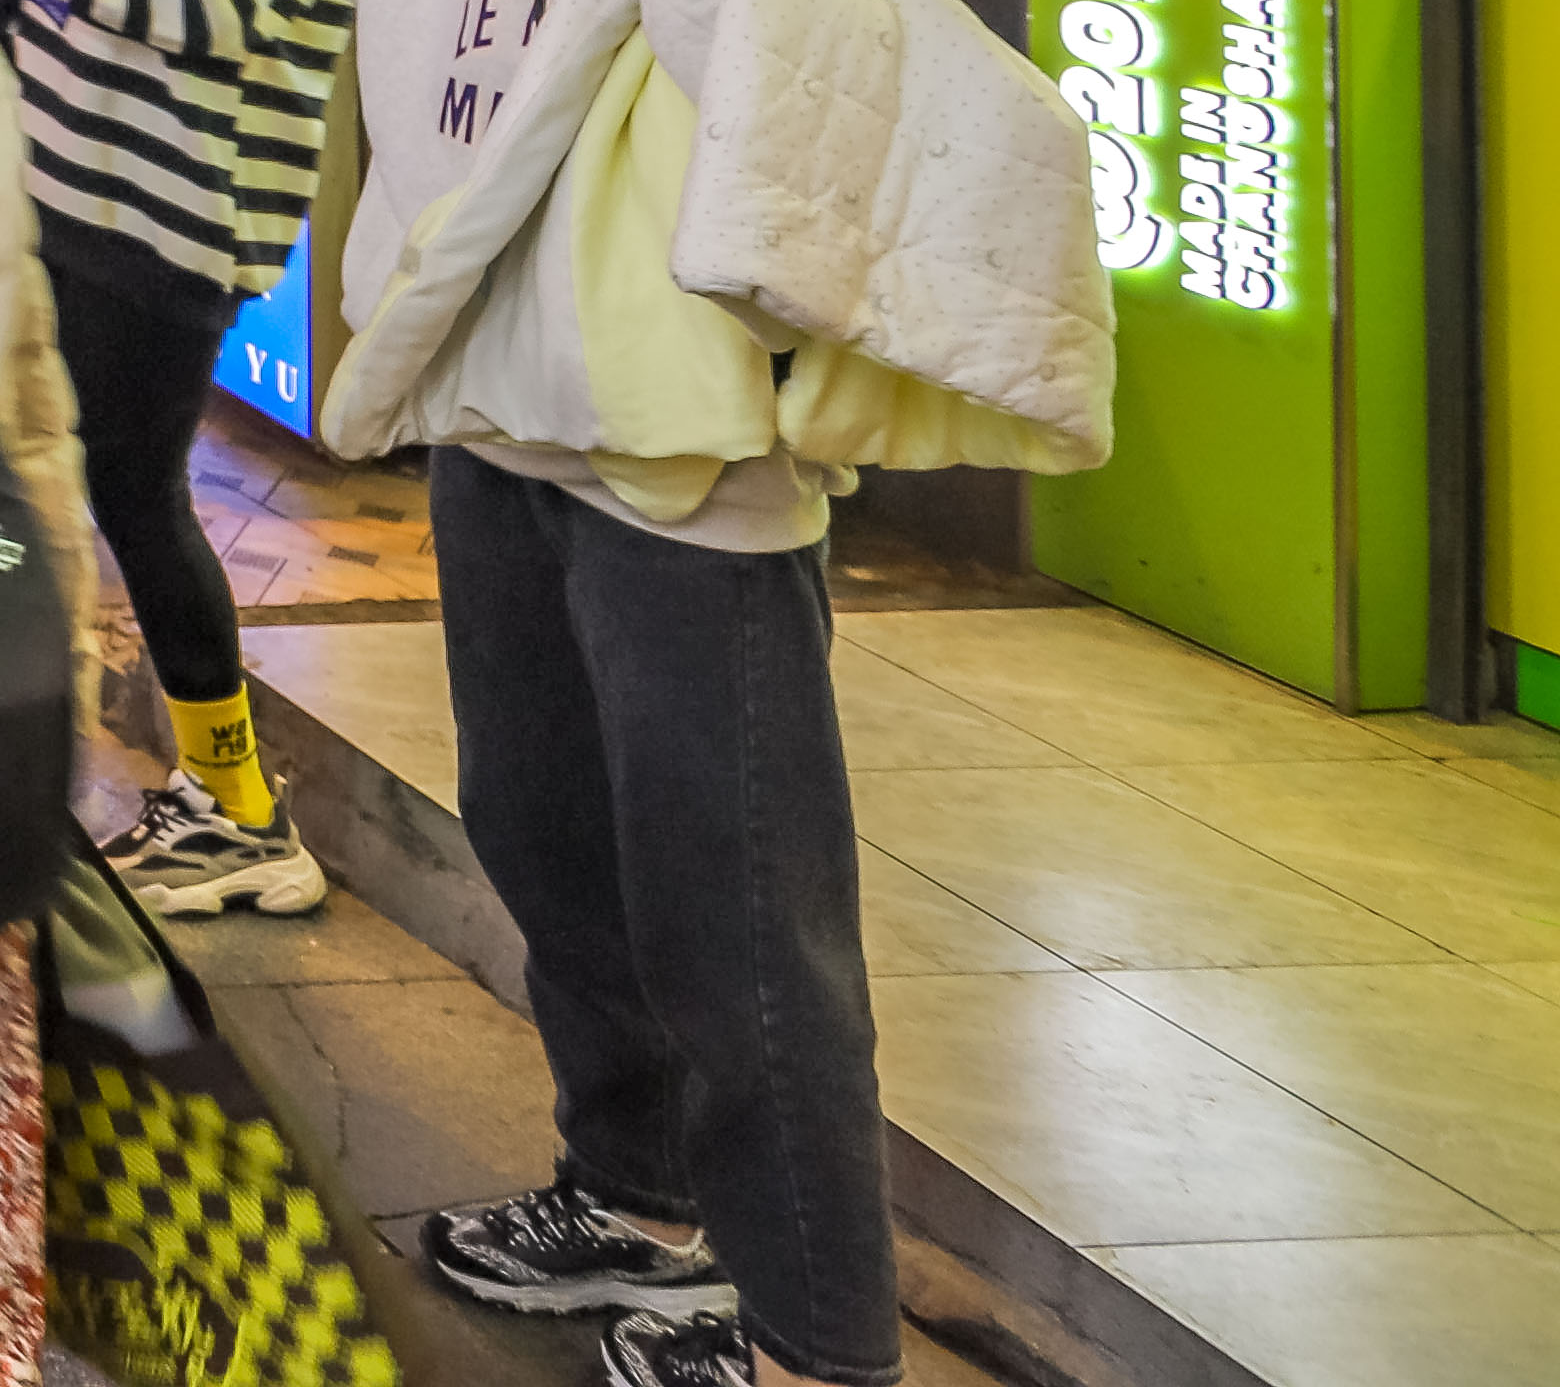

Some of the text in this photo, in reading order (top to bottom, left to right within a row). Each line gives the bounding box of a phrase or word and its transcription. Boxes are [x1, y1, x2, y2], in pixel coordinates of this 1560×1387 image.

[1179, 86, 1227, 299] MADE IN
[244, 341, 299, 405] YU
